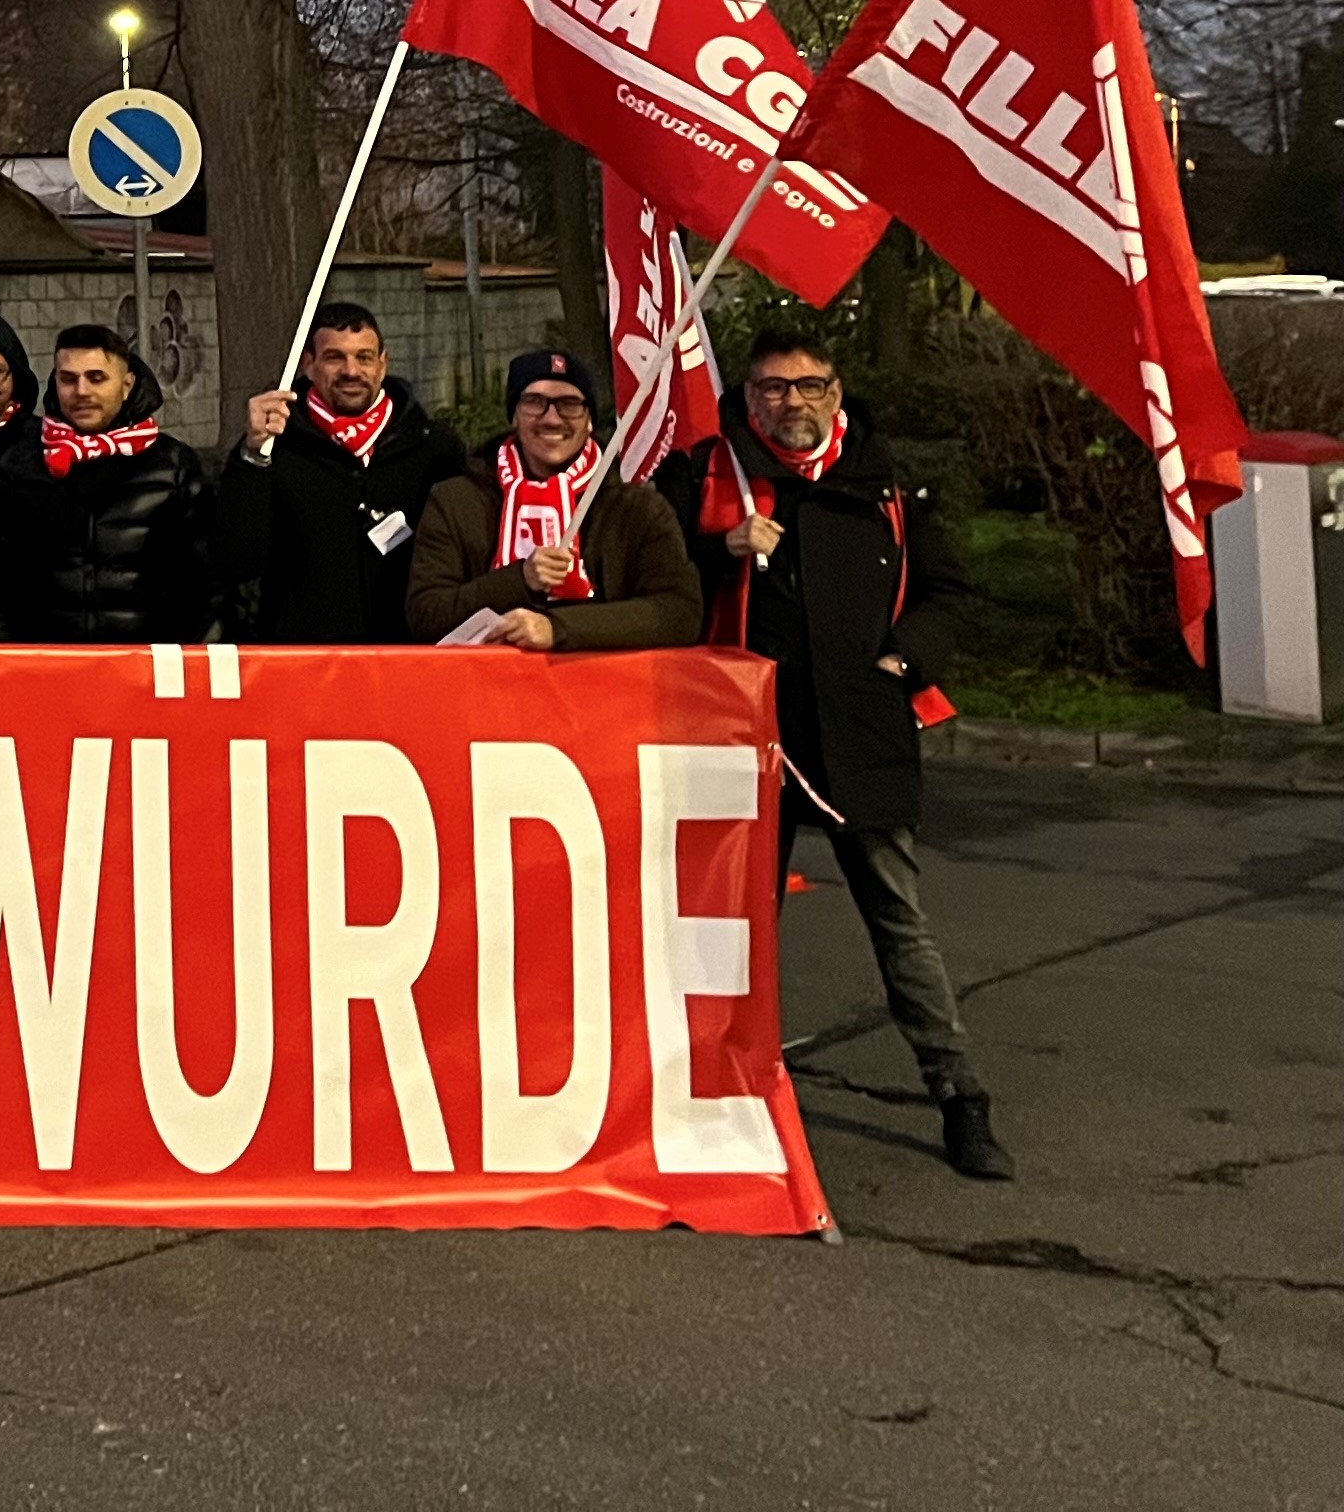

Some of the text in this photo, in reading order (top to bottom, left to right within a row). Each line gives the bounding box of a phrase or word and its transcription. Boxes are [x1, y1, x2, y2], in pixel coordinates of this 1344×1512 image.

[694, 35, 810, 136] CG
[615, 83, 836, 230] Costruzioni e egno
